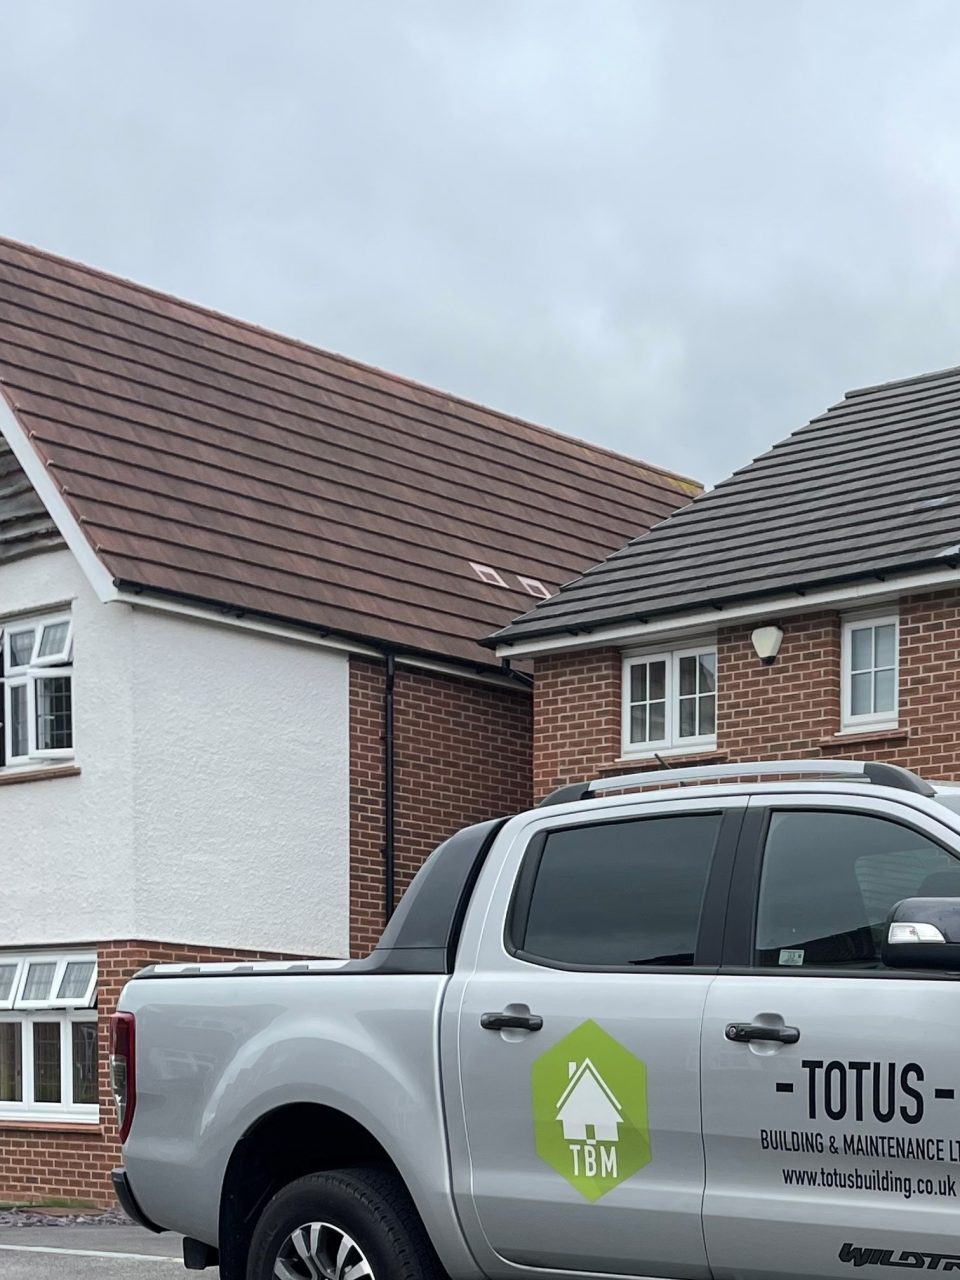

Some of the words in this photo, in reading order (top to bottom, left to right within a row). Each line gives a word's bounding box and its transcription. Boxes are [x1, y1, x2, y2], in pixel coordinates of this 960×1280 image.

[569, 1144, 617, 1178] TBM
[760, 1129, 824, 1154] BUILDING
[829, 1135, 839, 1155] &
[843, 1134, 944, 1161] MAINTENANCE
[782, 1167, 957, 1199] www.totusbuilding.co.uk
